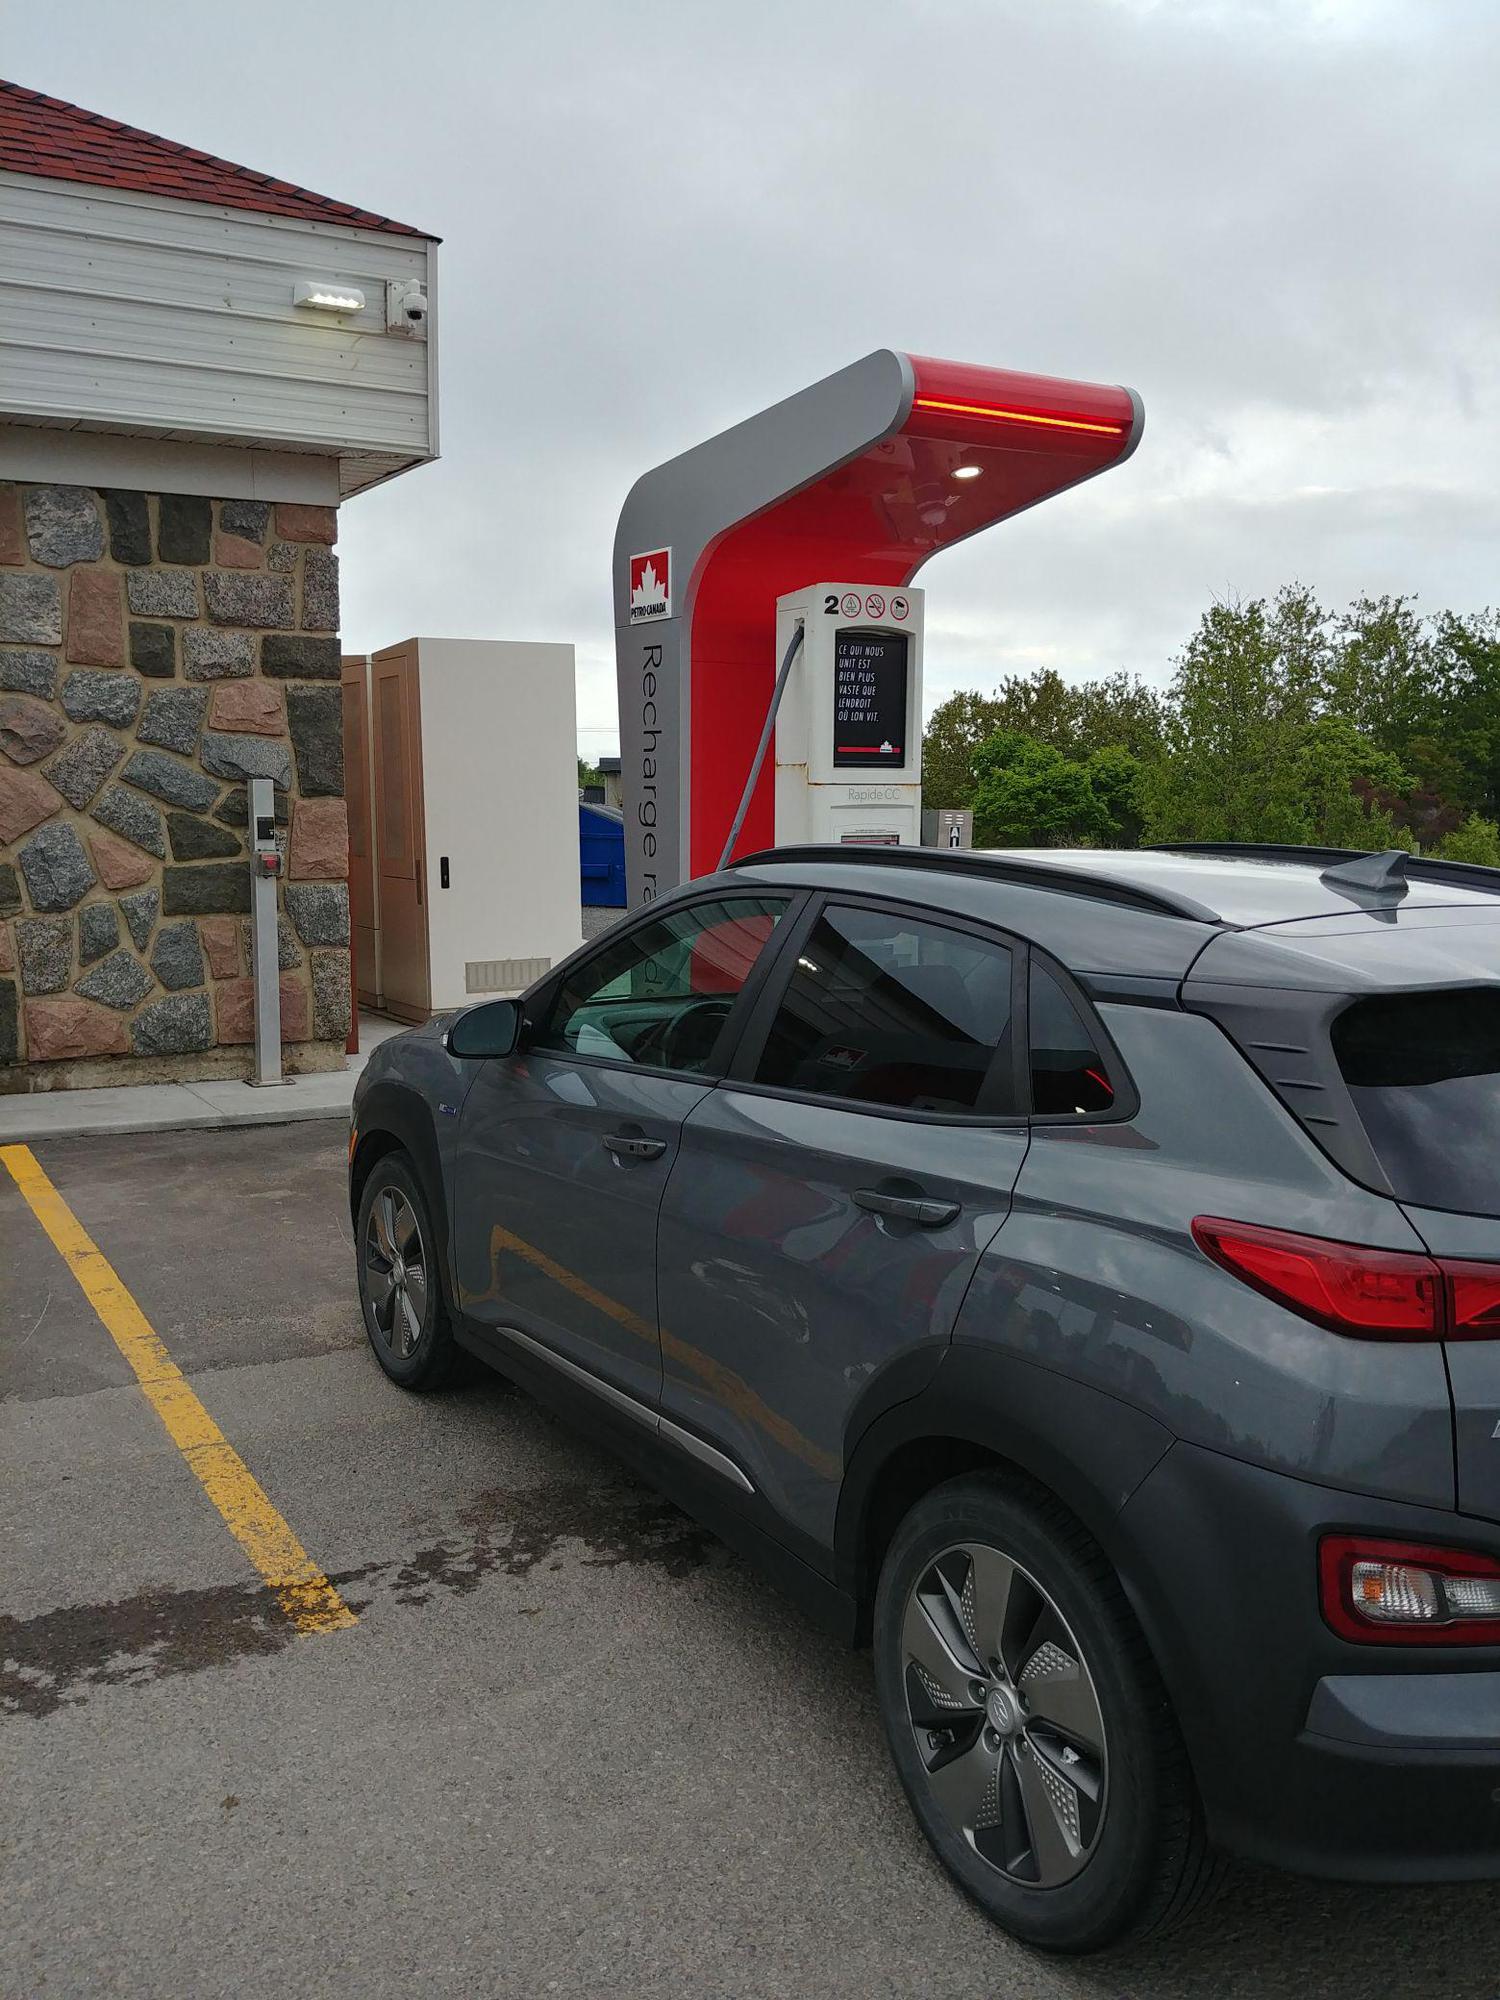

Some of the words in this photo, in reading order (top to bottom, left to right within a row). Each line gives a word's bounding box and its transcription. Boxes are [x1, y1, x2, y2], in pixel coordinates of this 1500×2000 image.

[824, 595, 839, 615] 2
[838, 645, 848, 655] CE
[849, 645, 863, 656] QUI
[864, 646, 884, 657] NOUS
[839, 658, 856, 669] UNIT
[857, 659, 871, 669] EST
[838, 671, 856, 682] BIEN
[857, 672, 876, 683] PLUS
[839, 685, 860, 695] VASTE
[862, 685, 877, 696] QUE
[638, 645, 662, 857] Recharge
[848, 788, 883, 803] Rapide
